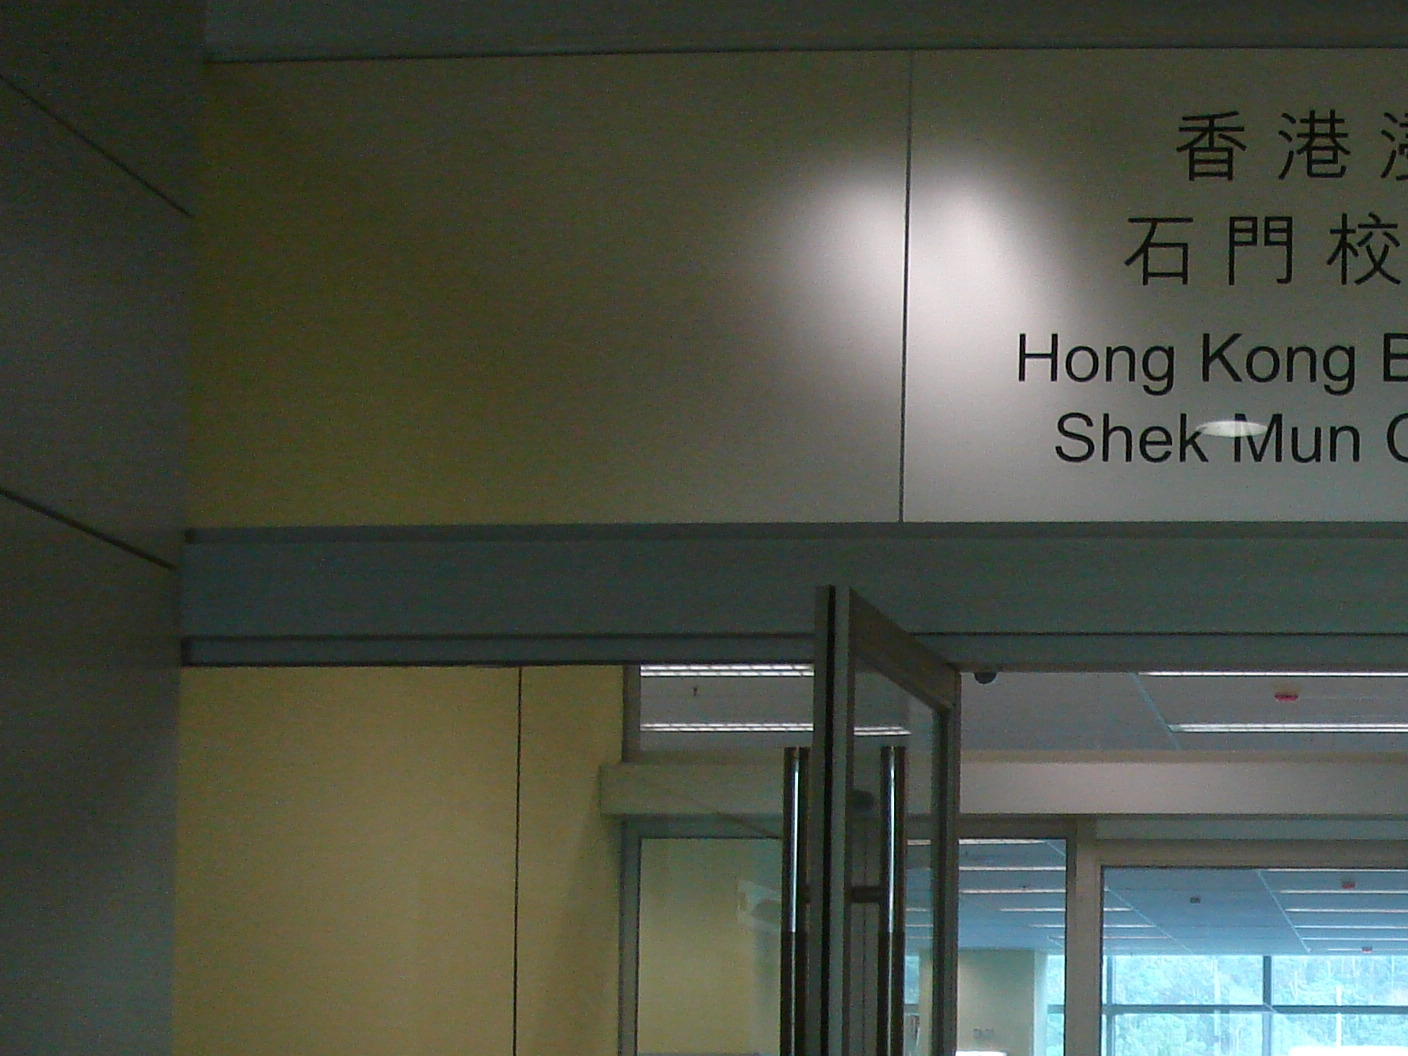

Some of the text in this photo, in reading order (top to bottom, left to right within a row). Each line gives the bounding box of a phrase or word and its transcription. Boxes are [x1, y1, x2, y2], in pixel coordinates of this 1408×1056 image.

[1018, 333, 1174, 396] Hong
[1202, 333, 1355, 396] Kong
[1055, 412, 1209, 463] Shek
[1233, 413, 1361, 463] Mun
